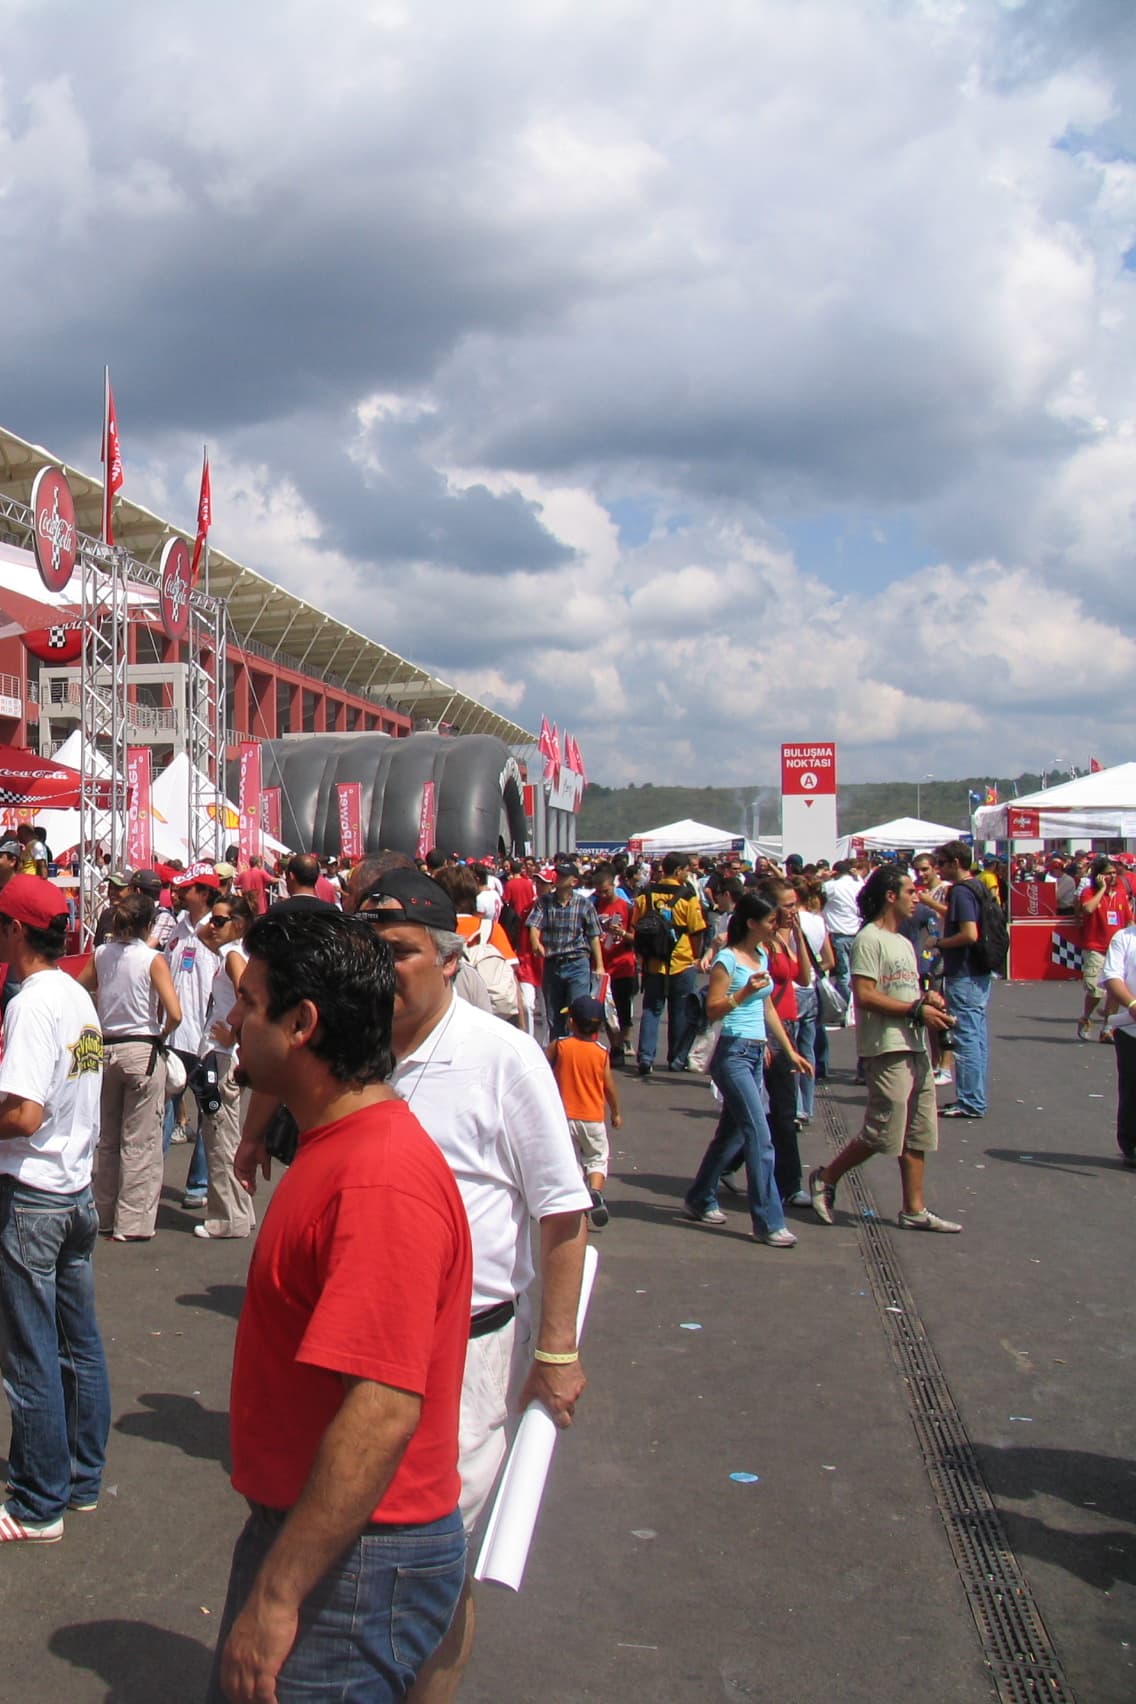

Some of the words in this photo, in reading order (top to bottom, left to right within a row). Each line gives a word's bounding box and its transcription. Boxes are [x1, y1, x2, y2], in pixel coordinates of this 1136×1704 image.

[784, 748, 832, 758] BULUŞMA
[786, 759, 830, 768] NOKTASI
[804, 775, 814, 786] A
